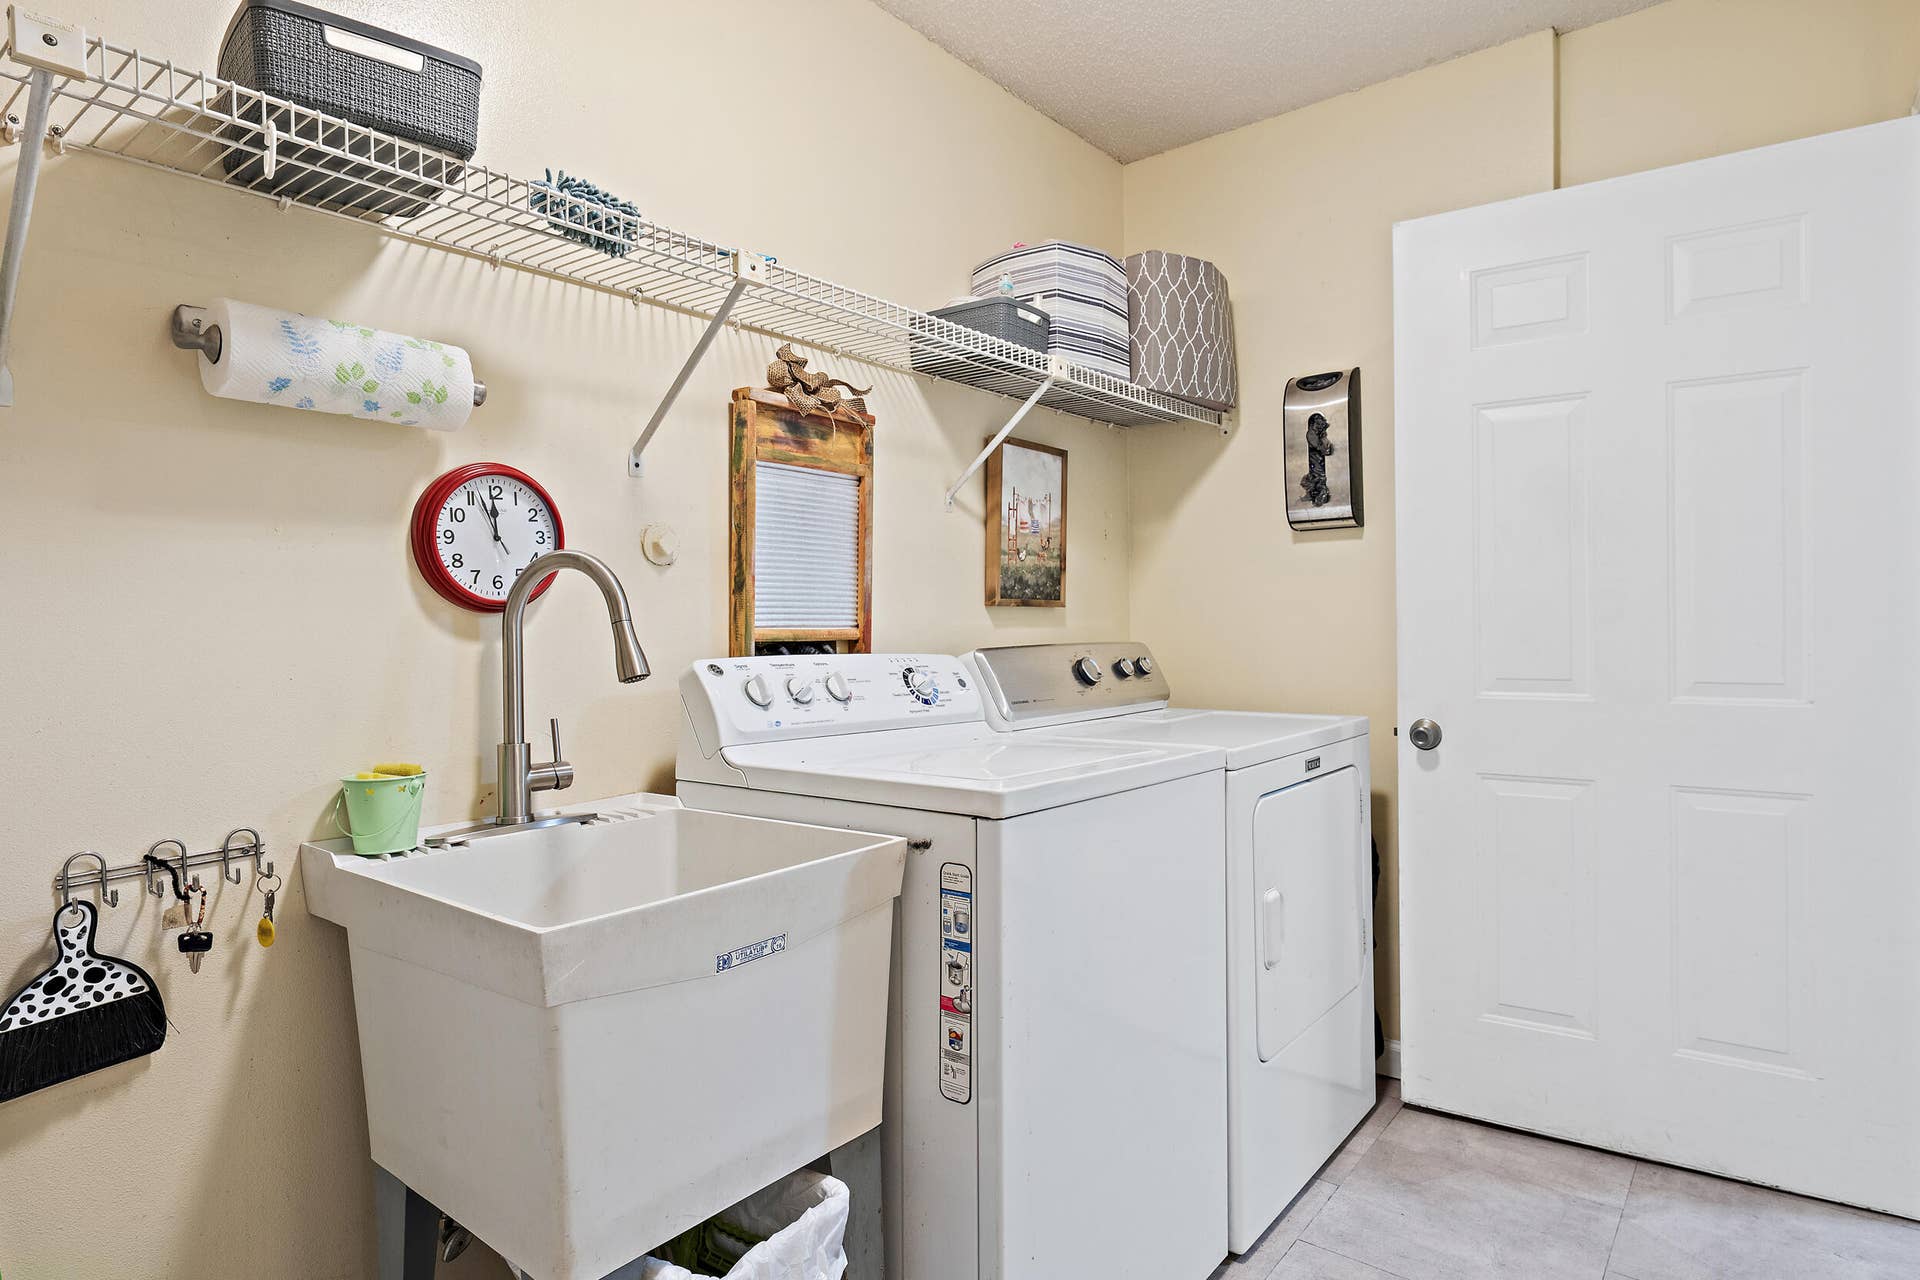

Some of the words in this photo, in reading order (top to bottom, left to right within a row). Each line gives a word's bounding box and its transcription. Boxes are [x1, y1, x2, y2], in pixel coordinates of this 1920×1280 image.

[466, 490, 475, 506] 11
[488, 485, 504, 500] 12
[513, 491, 518, 506] 1
[449, 507, 466, 523] 10
[527, 508, 539, 522] 2
[443, 529, 455, 545] 9
[535, 530, 546, 545] 3
[451, 553, 464, 568] 8
[470, 569, 481, 585] 7
[492, 575, 504, 590] 6
